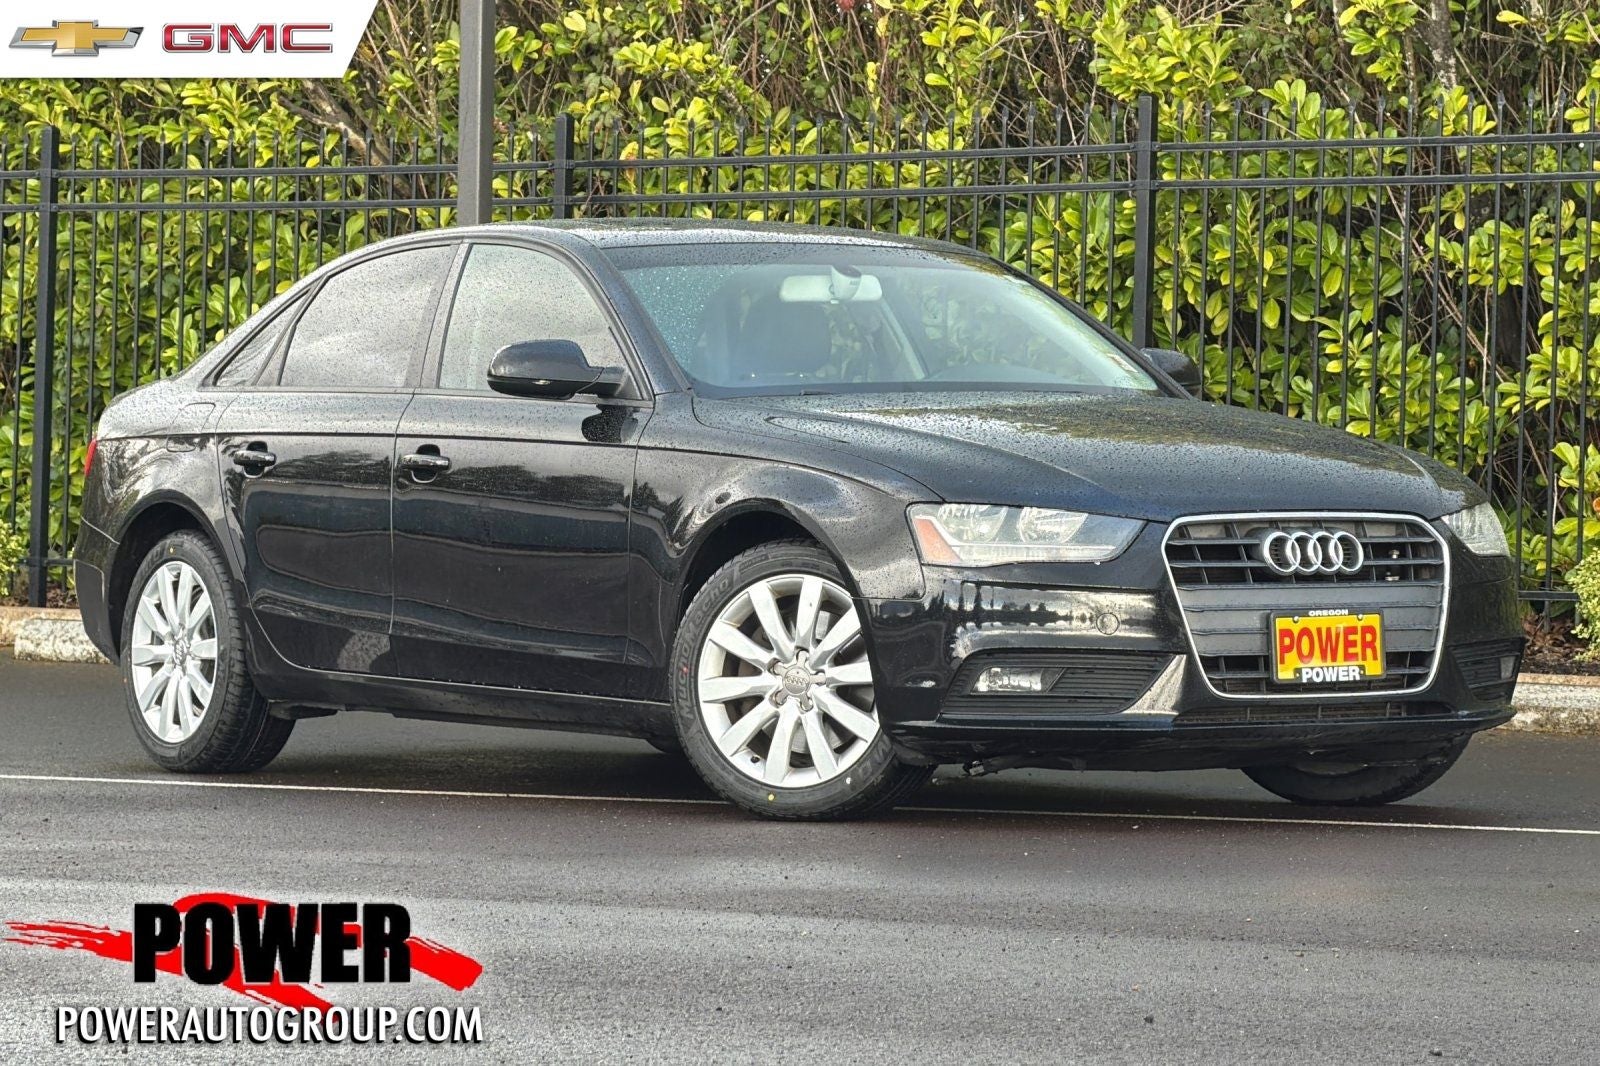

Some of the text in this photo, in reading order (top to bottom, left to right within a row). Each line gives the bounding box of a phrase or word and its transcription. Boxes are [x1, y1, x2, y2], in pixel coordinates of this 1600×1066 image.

[1308, 609, 1349, 617] OREGON
[1278, 625, 1378, 665] POWER
[1301, 666, 1361, 683] POWER
